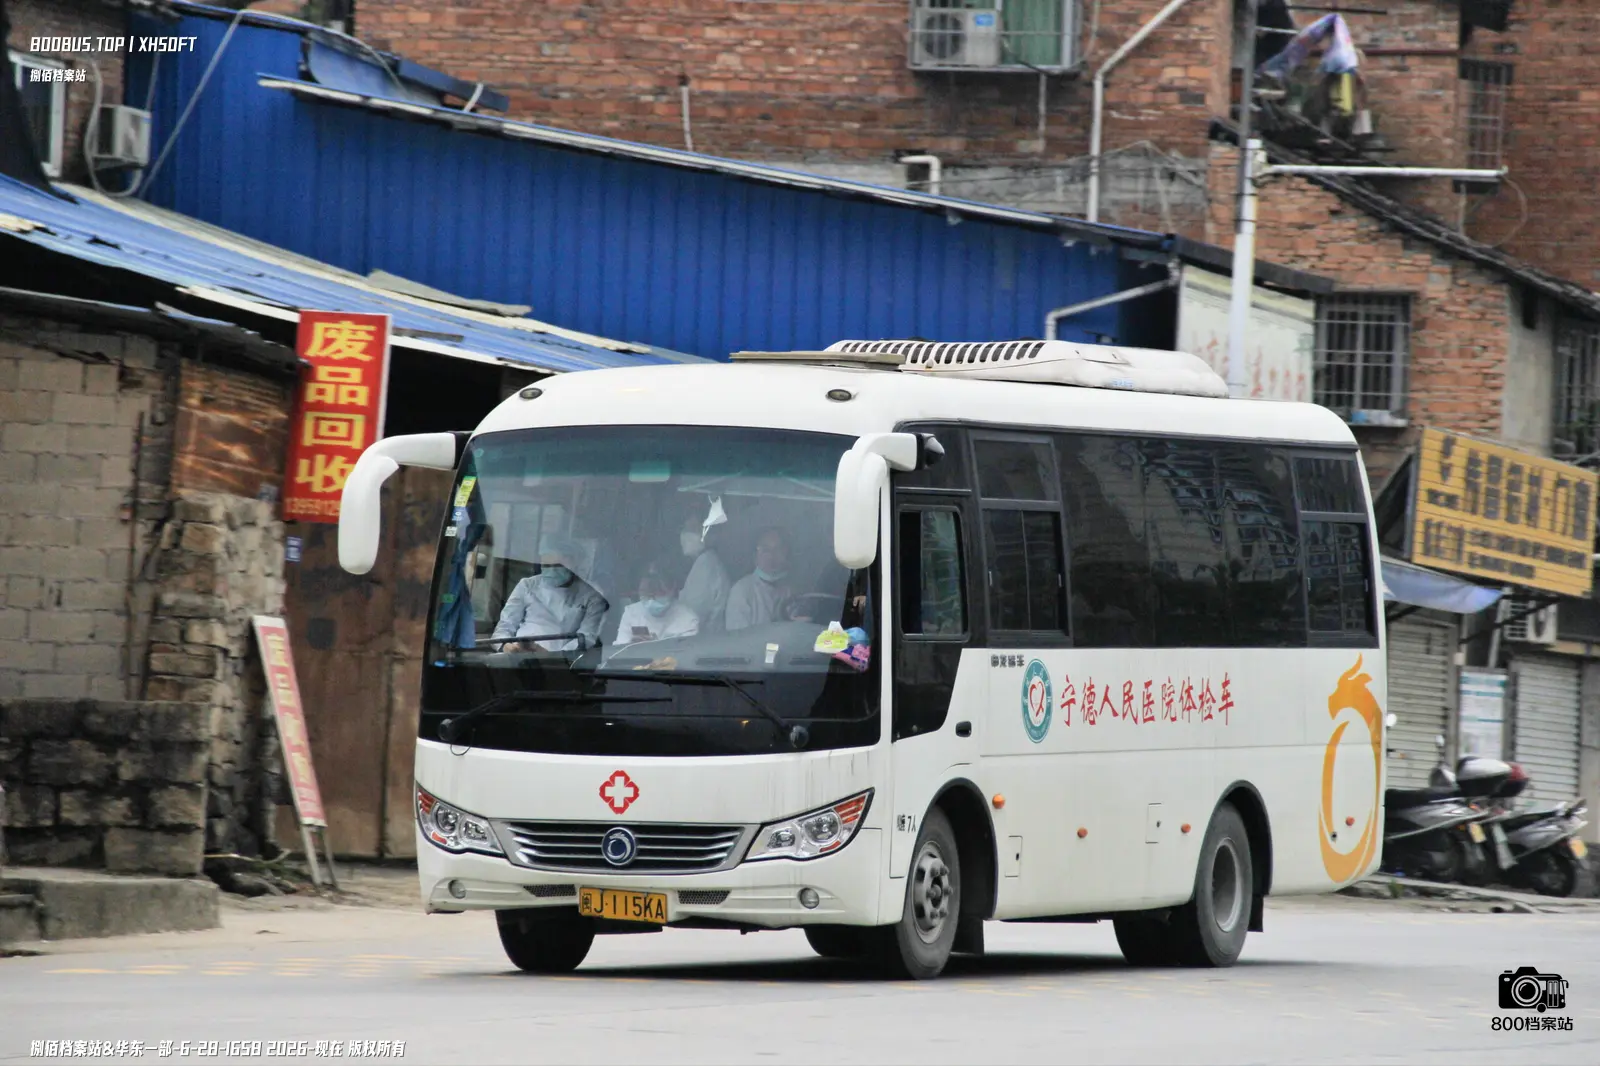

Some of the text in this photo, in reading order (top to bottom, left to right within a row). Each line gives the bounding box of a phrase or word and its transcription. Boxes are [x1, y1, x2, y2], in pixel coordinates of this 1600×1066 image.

[295, 320, 376, 493] 废品回收
[1060, 672, 1235, 727] 宁德人民医院体检车
